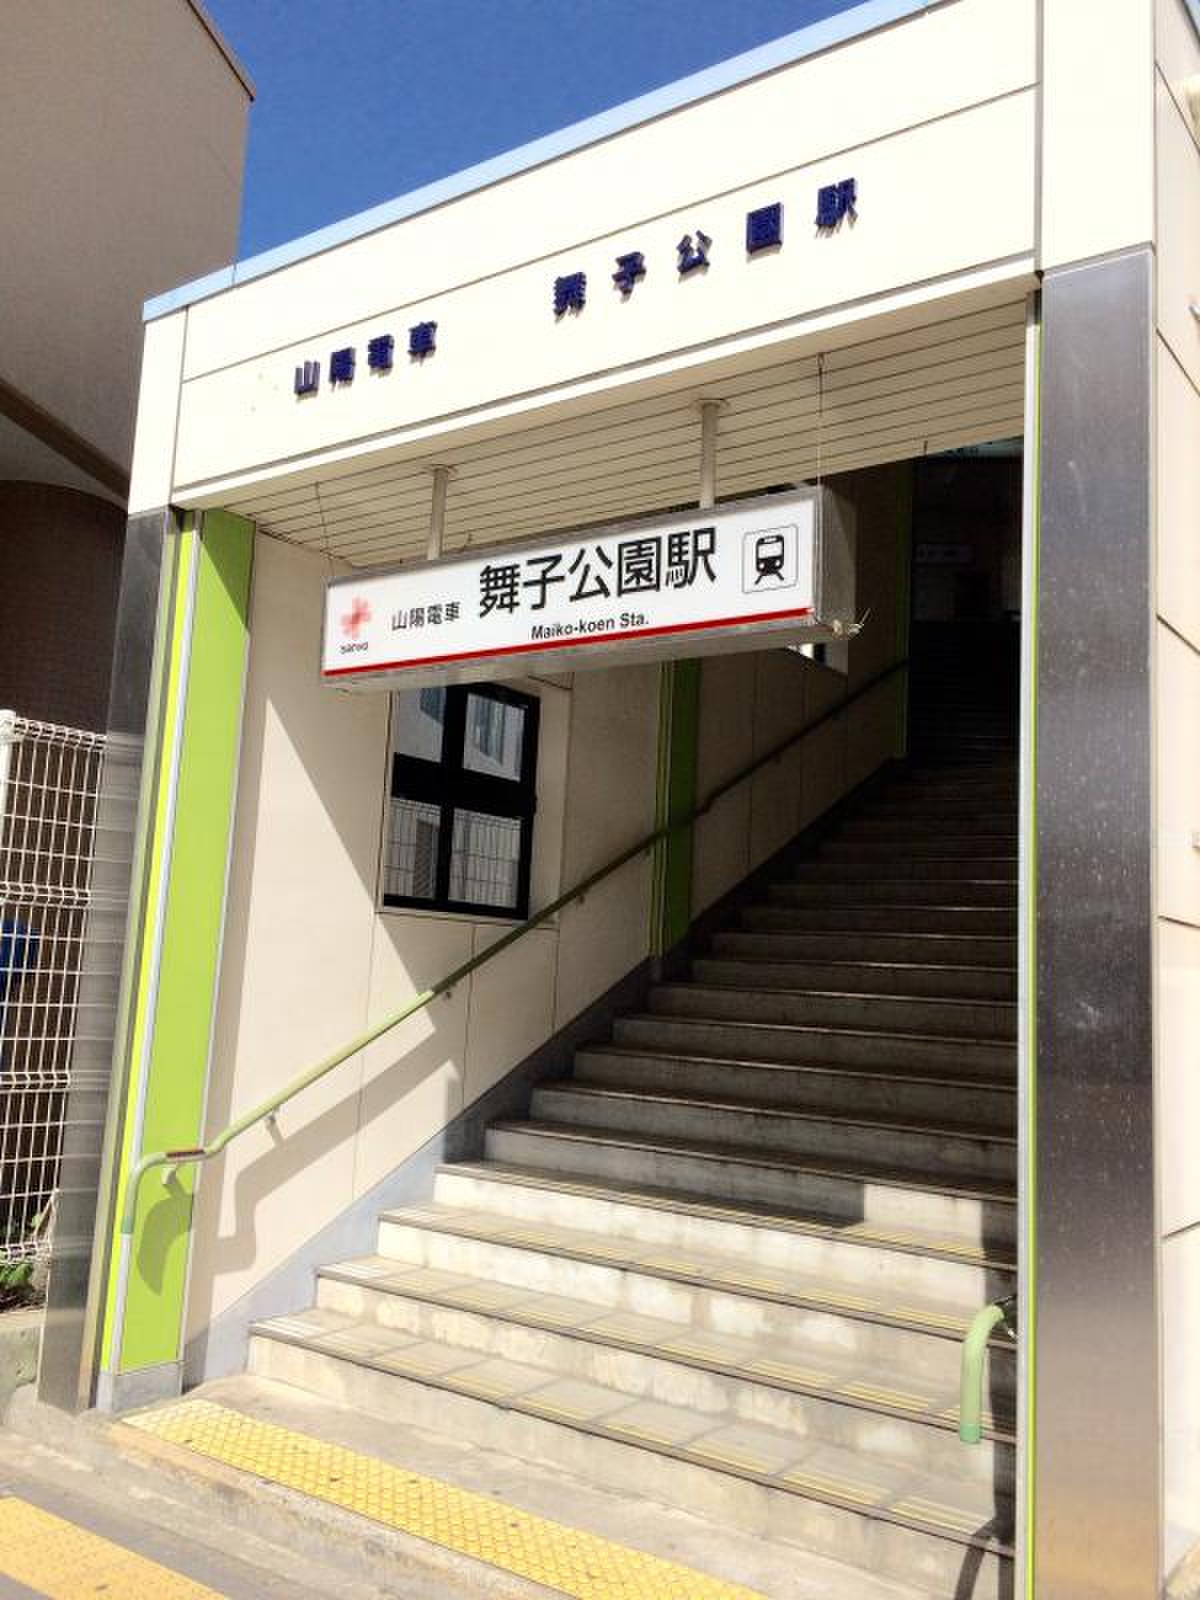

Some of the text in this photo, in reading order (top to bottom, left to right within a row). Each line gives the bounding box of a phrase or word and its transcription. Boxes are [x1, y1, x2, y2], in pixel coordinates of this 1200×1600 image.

[294, 178, 858, 397] 山陽電車 舞子公園駅
[479, 527, 717, 618] 舞子公園駅
[391, 601, 461, 631] 山陽電車
[531, 613, 650, 640] Maiko-koen Sta.
